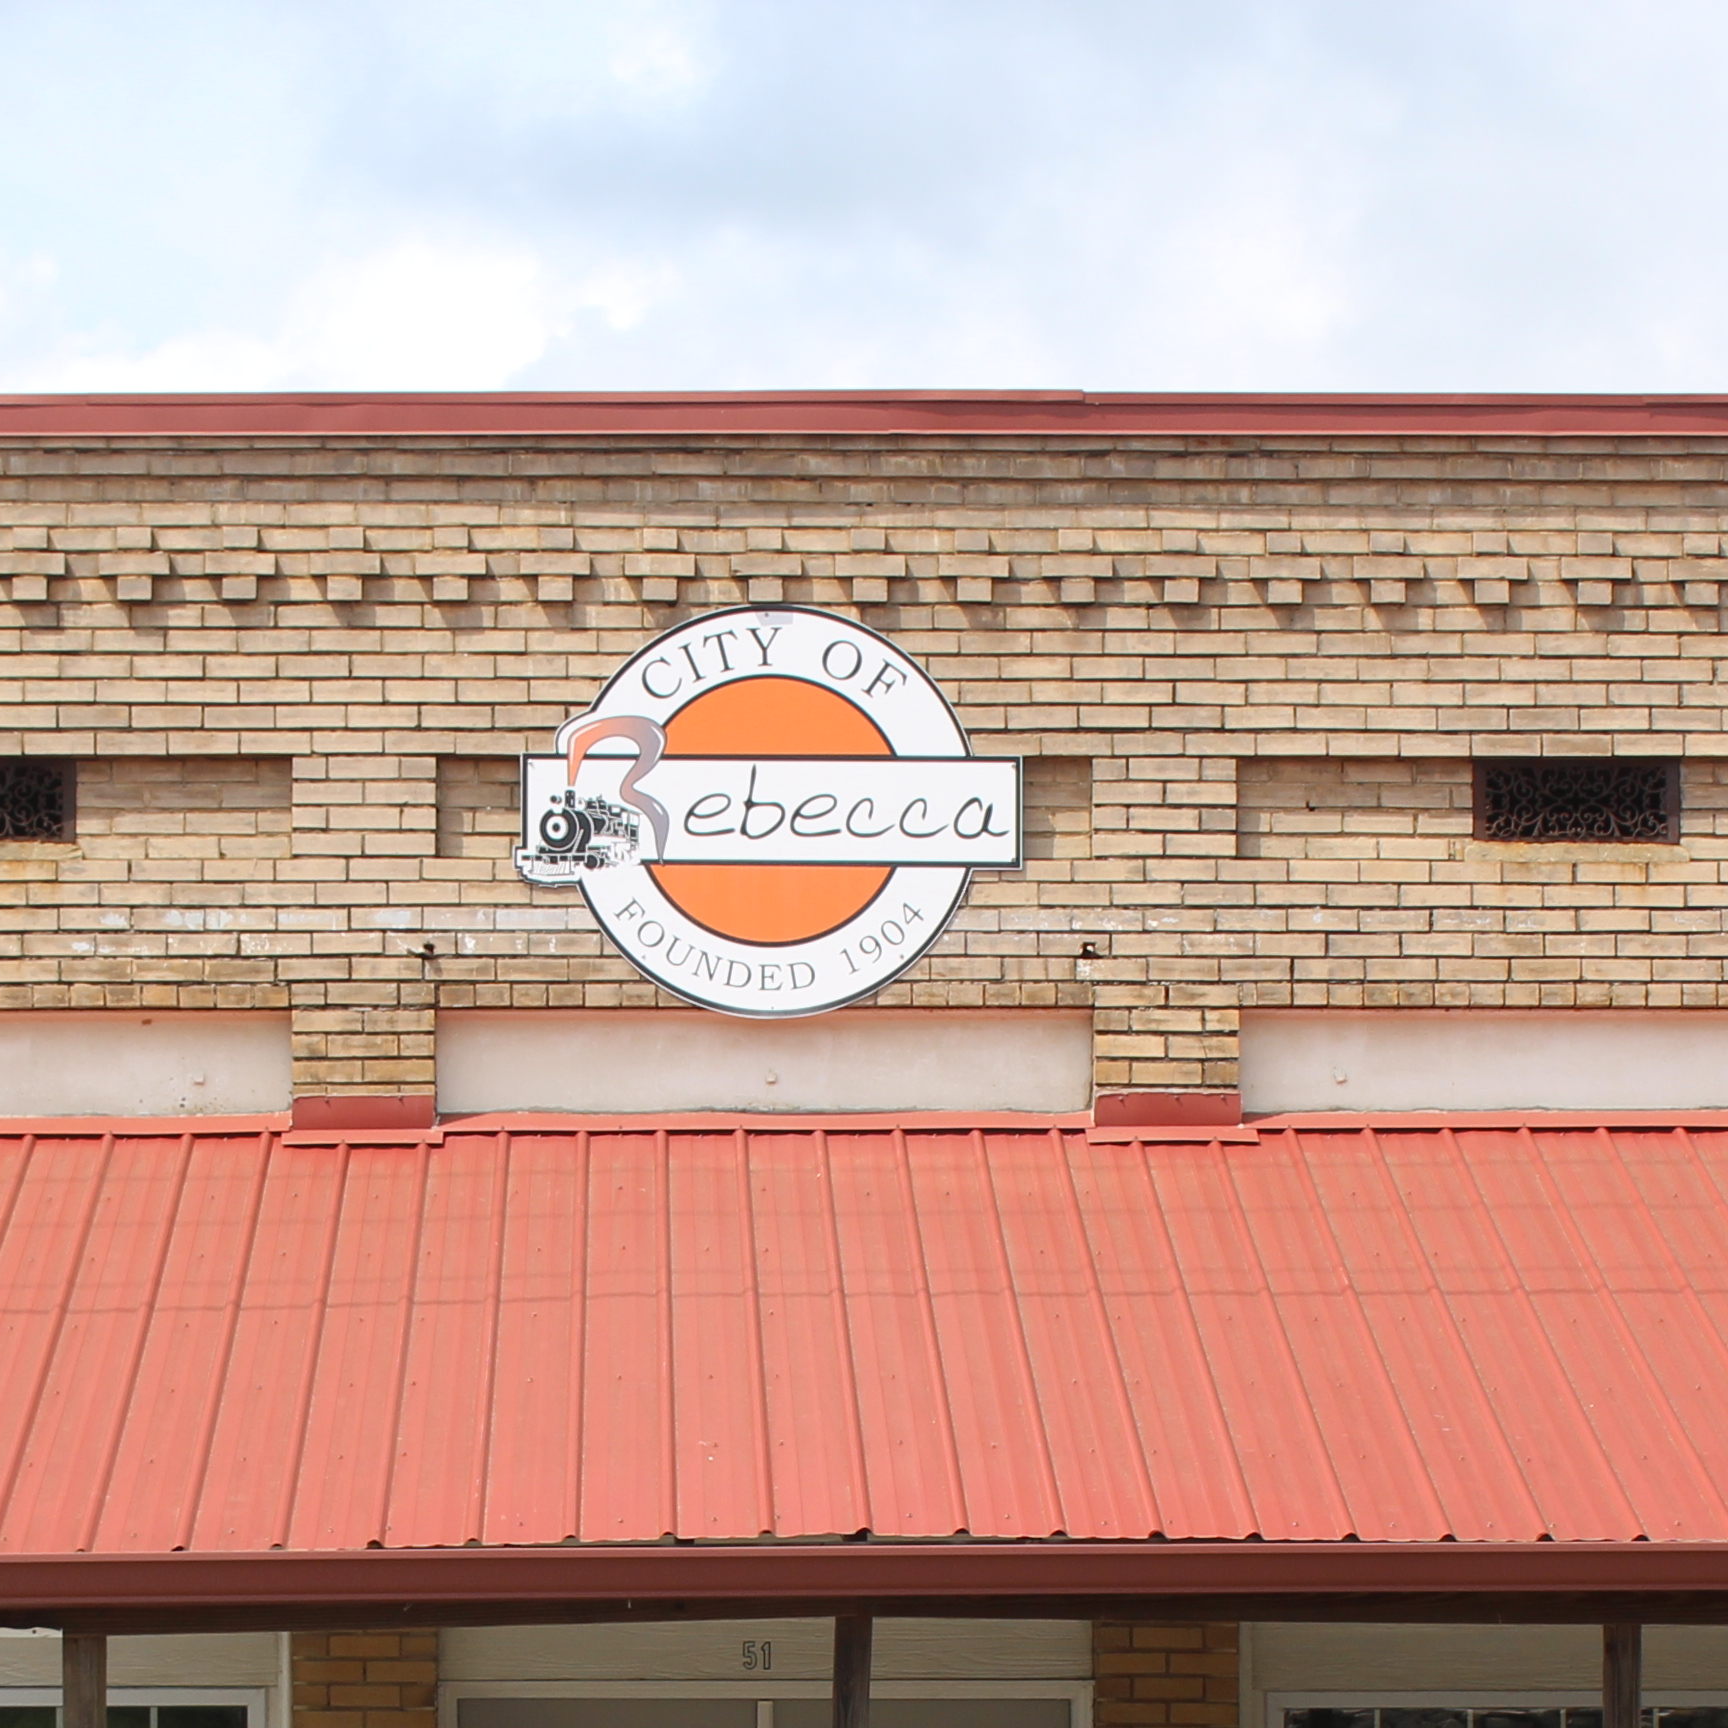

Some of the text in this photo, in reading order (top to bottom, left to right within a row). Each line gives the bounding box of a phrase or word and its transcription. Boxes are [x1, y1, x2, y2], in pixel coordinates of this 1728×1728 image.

[641, 626, 908, 700] CITY OF
[566, 714, 1010, 864] Rebecca
[613, 896, 925, 993] FOUNDED 1904
[741, 1640, 772, 1671] 51
